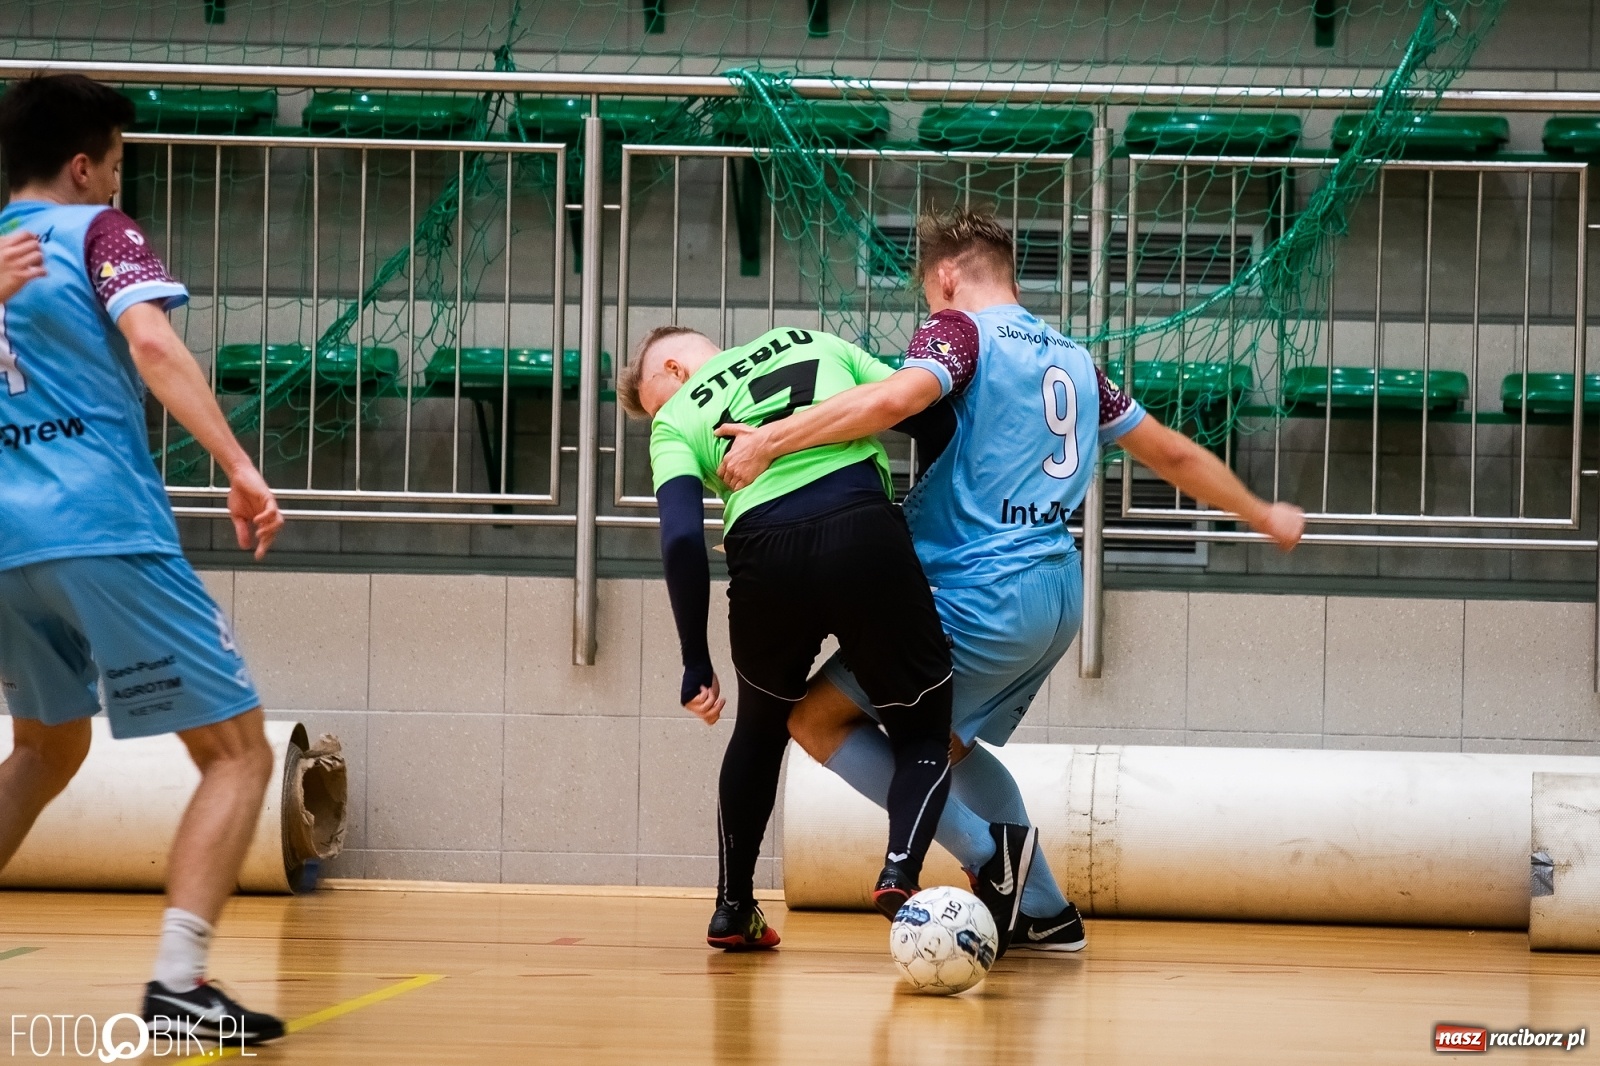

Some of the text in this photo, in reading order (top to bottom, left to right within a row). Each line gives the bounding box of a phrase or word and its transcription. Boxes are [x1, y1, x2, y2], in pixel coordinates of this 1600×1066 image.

[689, 329, 814, 409] STEBLU
[1041, 364, 1080, 480] 9
[1001, 498, 1076, 526] Int-Dr
